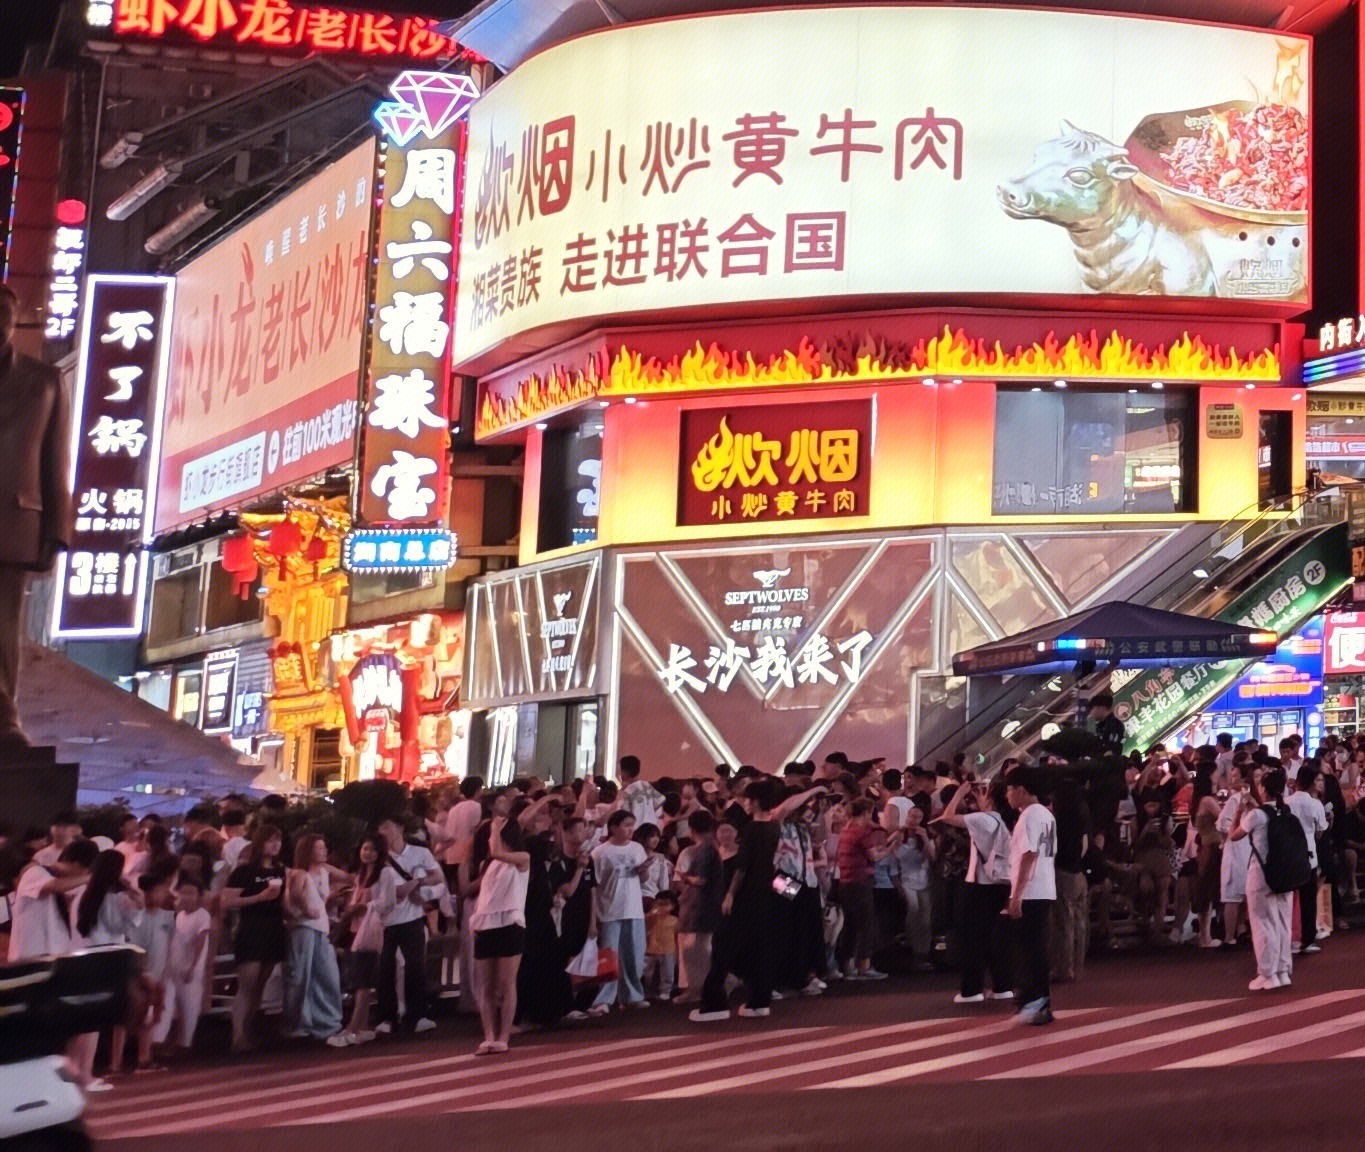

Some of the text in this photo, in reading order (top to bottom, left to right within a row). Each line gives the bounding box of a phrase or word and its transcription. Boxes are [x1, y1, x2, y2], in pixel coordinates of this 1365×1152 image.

[470, 210, 848, 332] 湘菜贵族 走进联合国
[45, 317, 76, 337] 2F
[369, 147, 457, 520] 周六福珠宝
[88, 309, 155, 459] 不了锅
[78, 488, 144, 516] 火锅
[709, 489, 858, 521] 小炒黄牛肉
[725, 588, 809, 605] SEPTWOLVES
[657, 629, 874, 695] 长沙我来了
